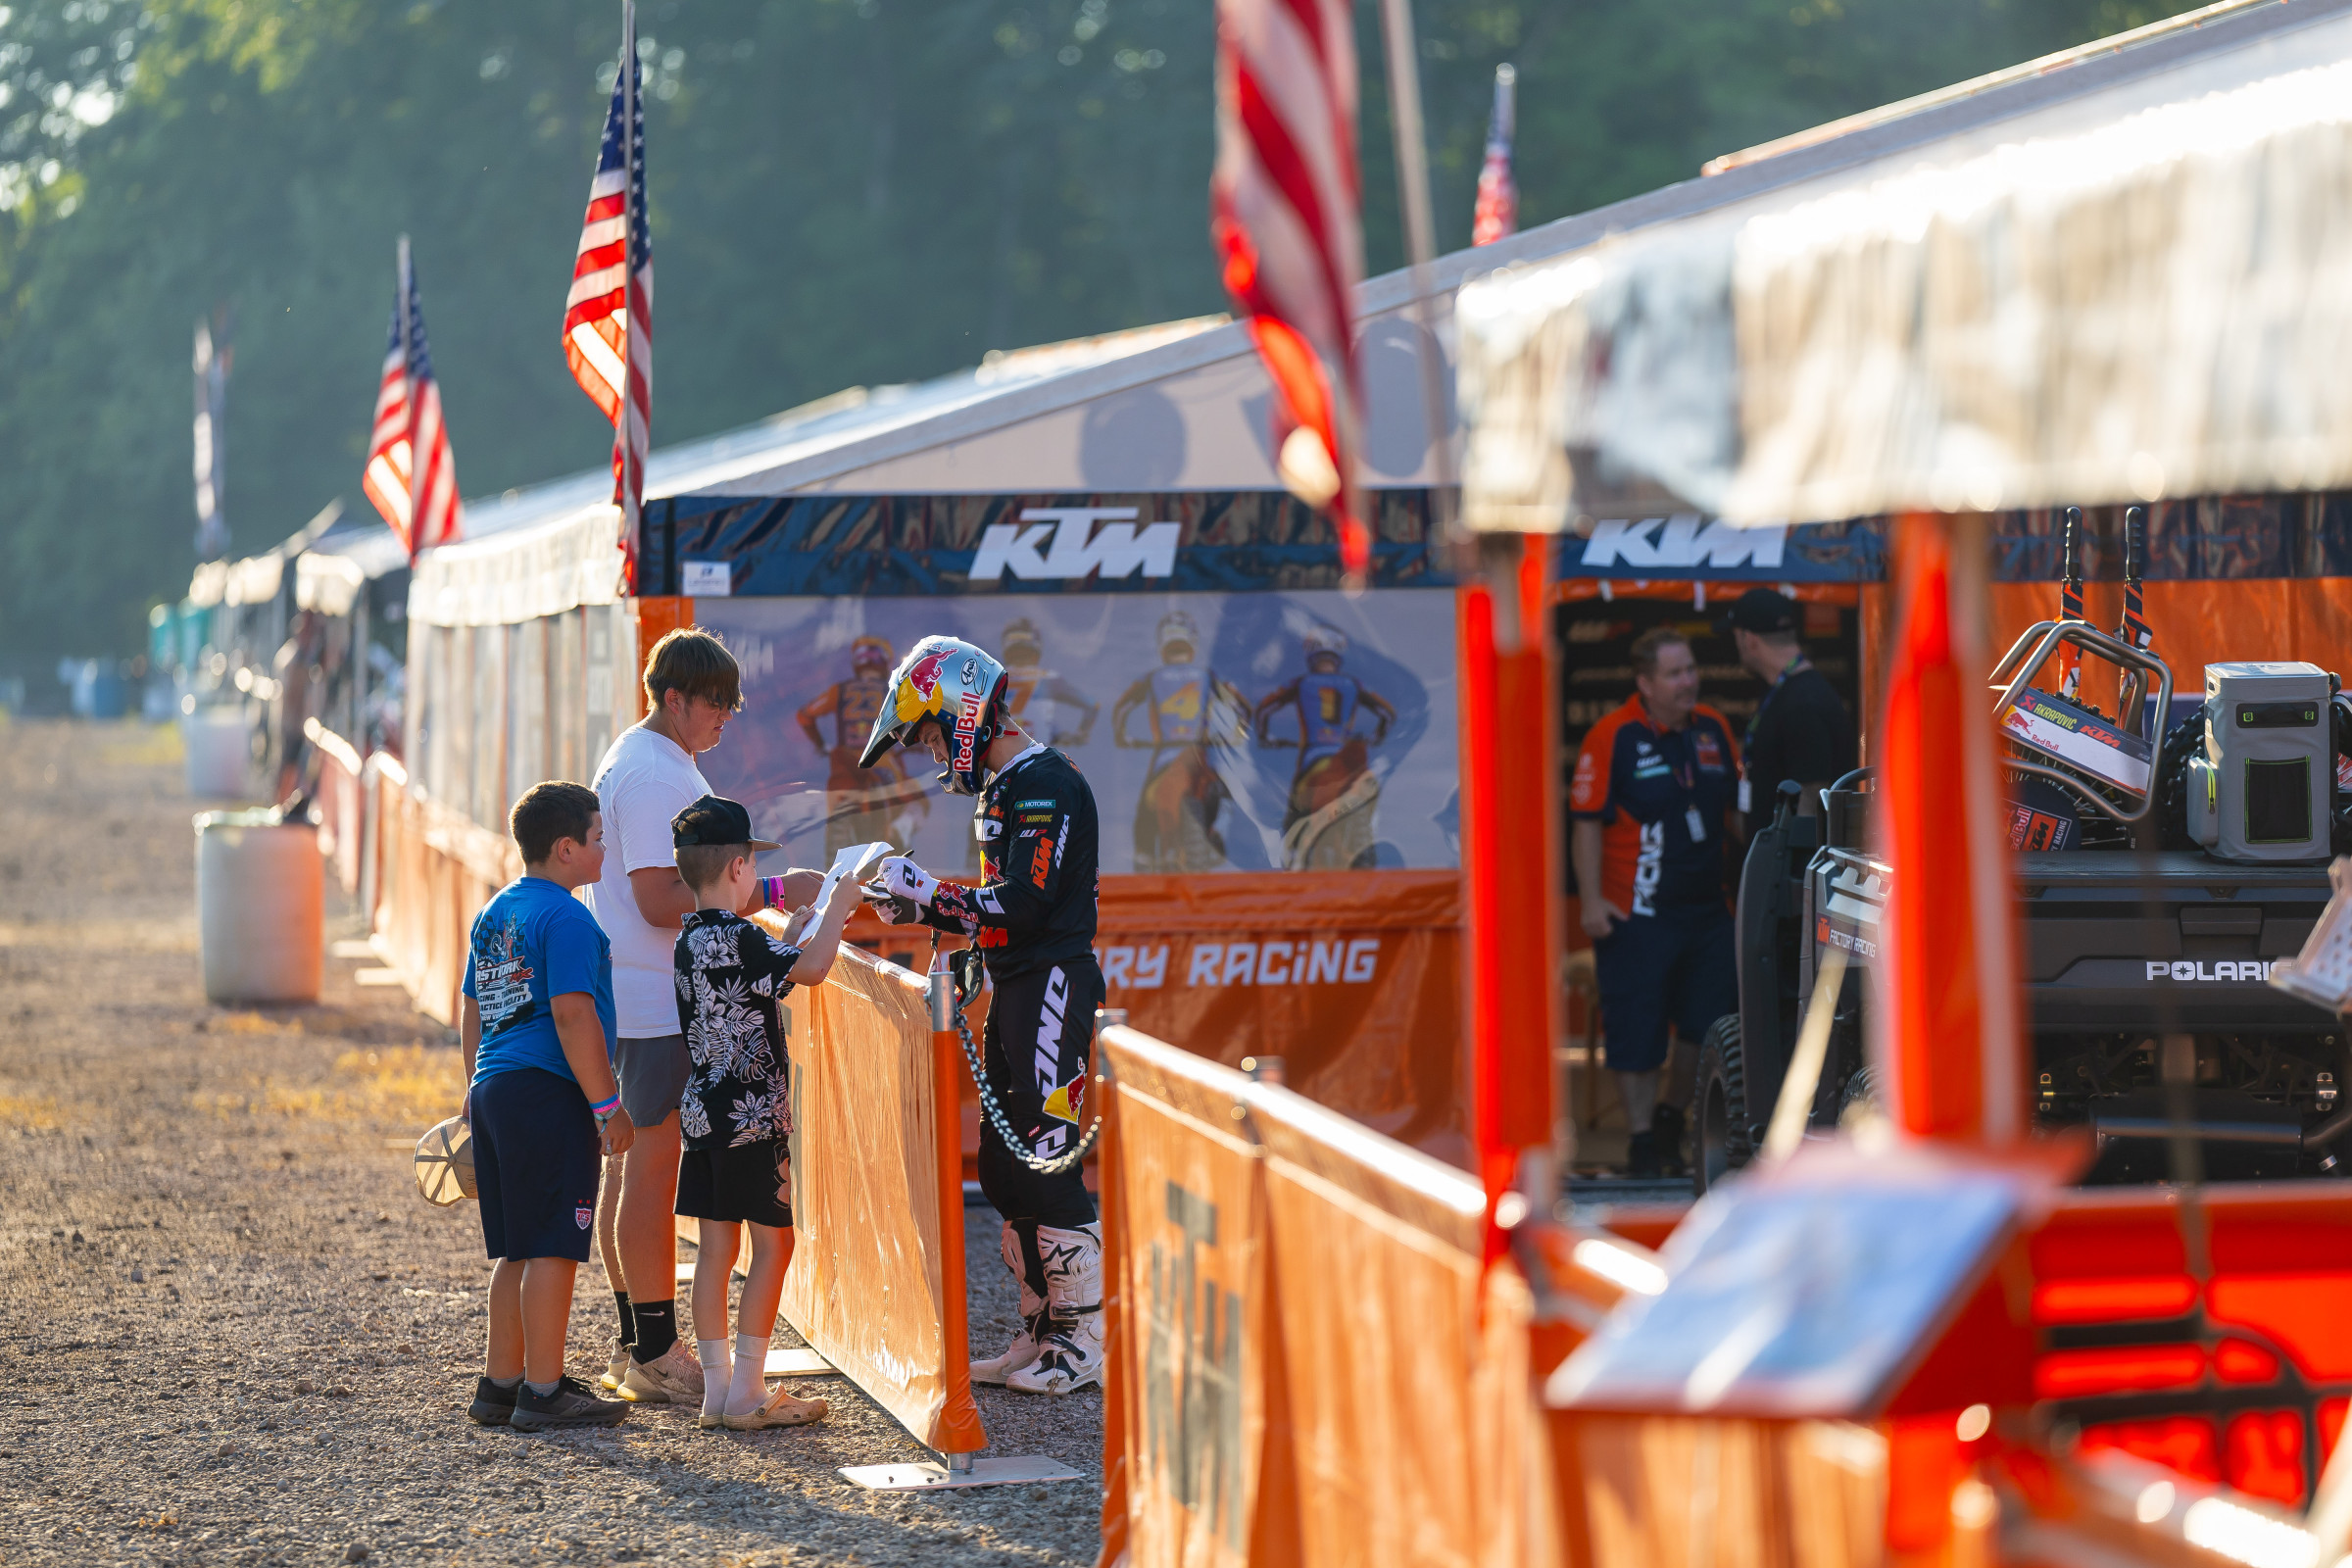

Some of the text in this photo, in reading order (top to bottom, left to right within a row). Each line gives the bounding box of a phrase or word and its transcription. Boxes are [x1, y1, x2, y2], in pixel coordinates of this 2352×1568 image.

[968, 508, 1180, 580] KTM
[1581, 512, 1788, 568] KTM
[2080, 725, 2121, 749] KTM
[1031, 837, 1054, 890] KTM
[1830, 929, 1855, 951] FACTORY
[1854, 937, 1877, 958] RACING
